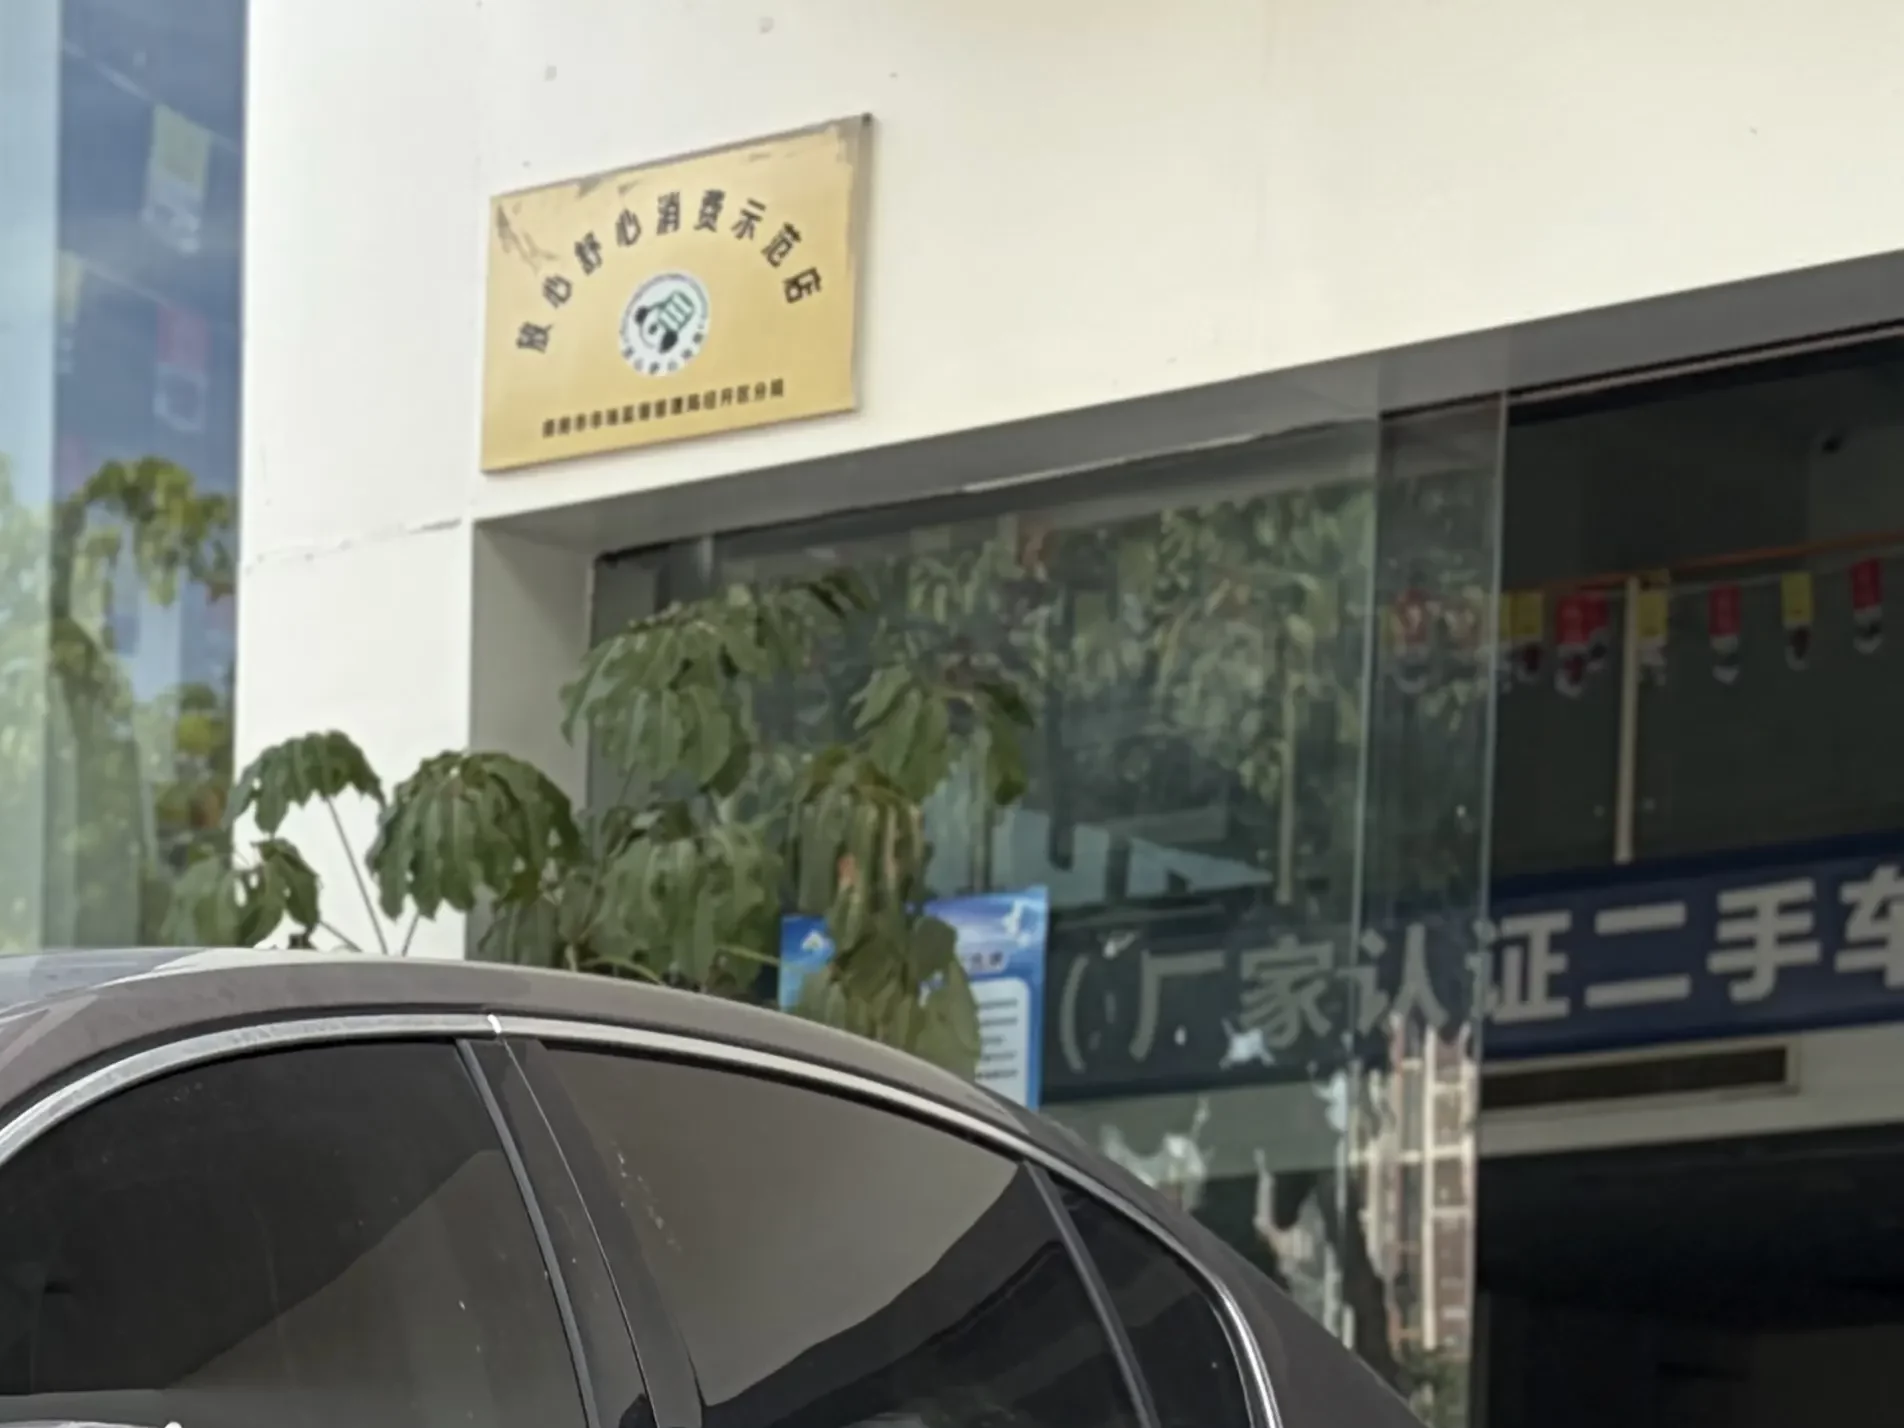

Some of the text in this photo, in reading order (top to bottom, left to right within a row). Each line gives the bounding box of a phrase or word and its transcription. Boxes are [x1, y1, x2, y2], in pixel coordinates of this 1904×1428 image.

[516, 188, 823, 354] 放心舒心消费示范店
